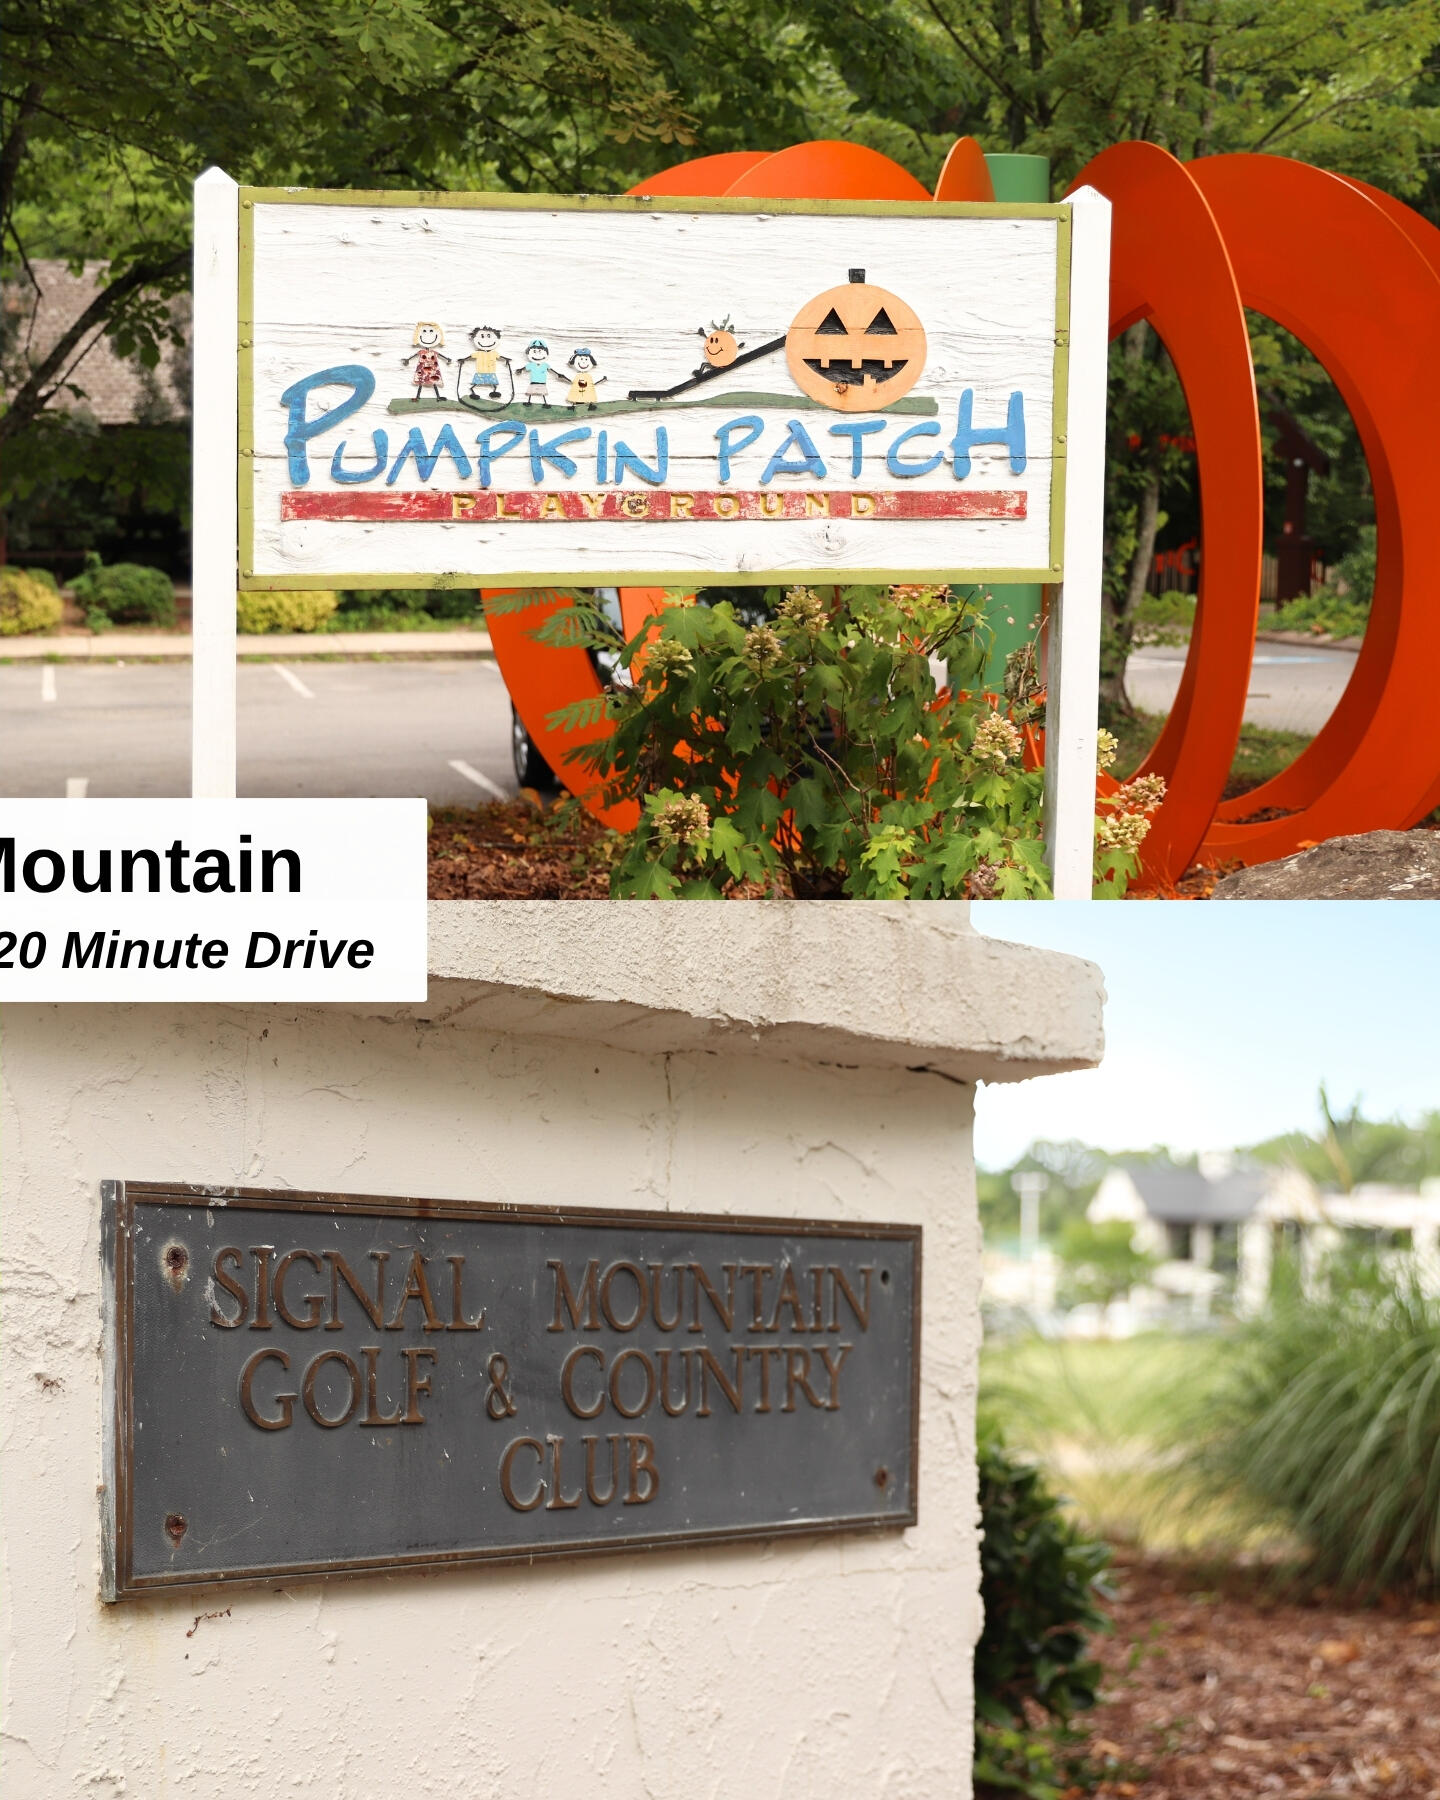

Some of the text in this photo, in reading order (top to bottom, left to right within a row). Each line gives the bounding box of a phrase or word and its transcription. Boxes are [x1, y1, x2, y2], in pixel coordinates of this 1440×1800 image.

[281, 364, 1027, 487] PUMPKIN PATCH
[452, 492, 876, 519] PLAYGROUND
[208, 1244, 874, 1334] SIGNAL MOUNTAIN
[238, 1343, 853, 1431] GOLF & COUNTRY
[499, 1432, 660, 1512] CLUB
